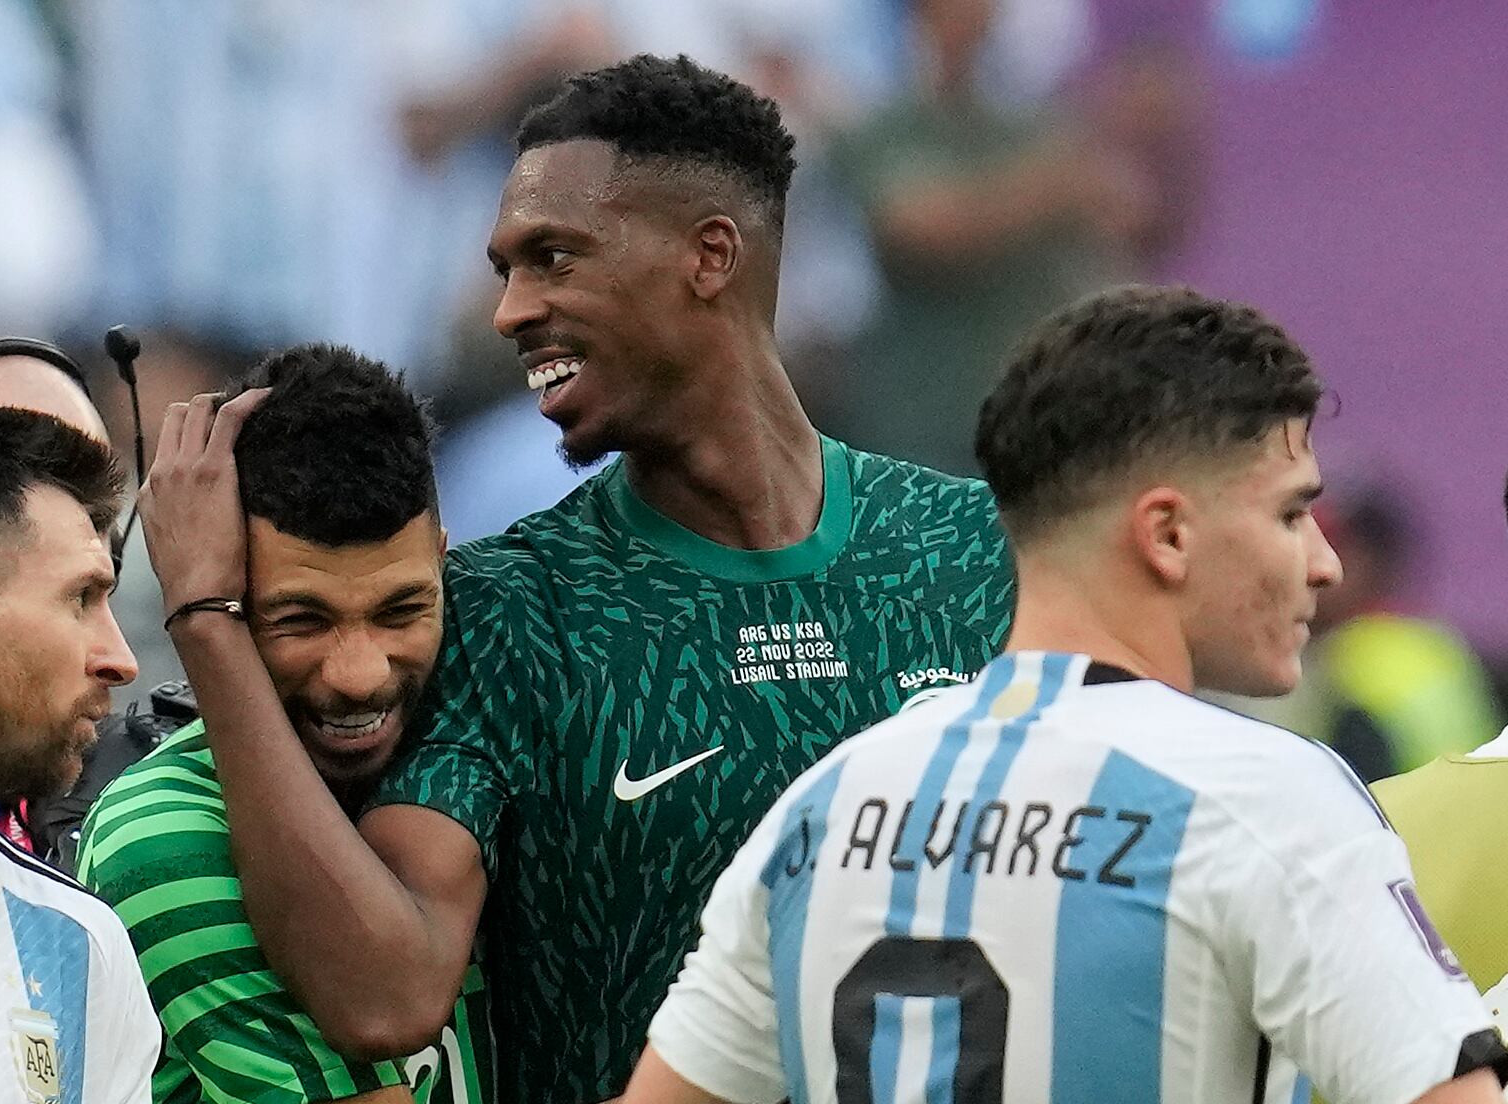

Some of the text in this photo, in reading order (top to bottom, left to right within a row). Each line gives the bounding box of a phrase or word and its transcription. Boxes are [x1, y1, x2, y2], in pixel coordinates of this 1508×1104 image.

[739, 624, 767, 643] ARG
[796, 621, 824, 639] KSA
[736, 647, 757, 664] 22
[794, 641, 835, 659] 2022
[731, 661, 849, 685] LUSAIL STADIUM
[841, 798, 1153, 887] ALVAREZ
